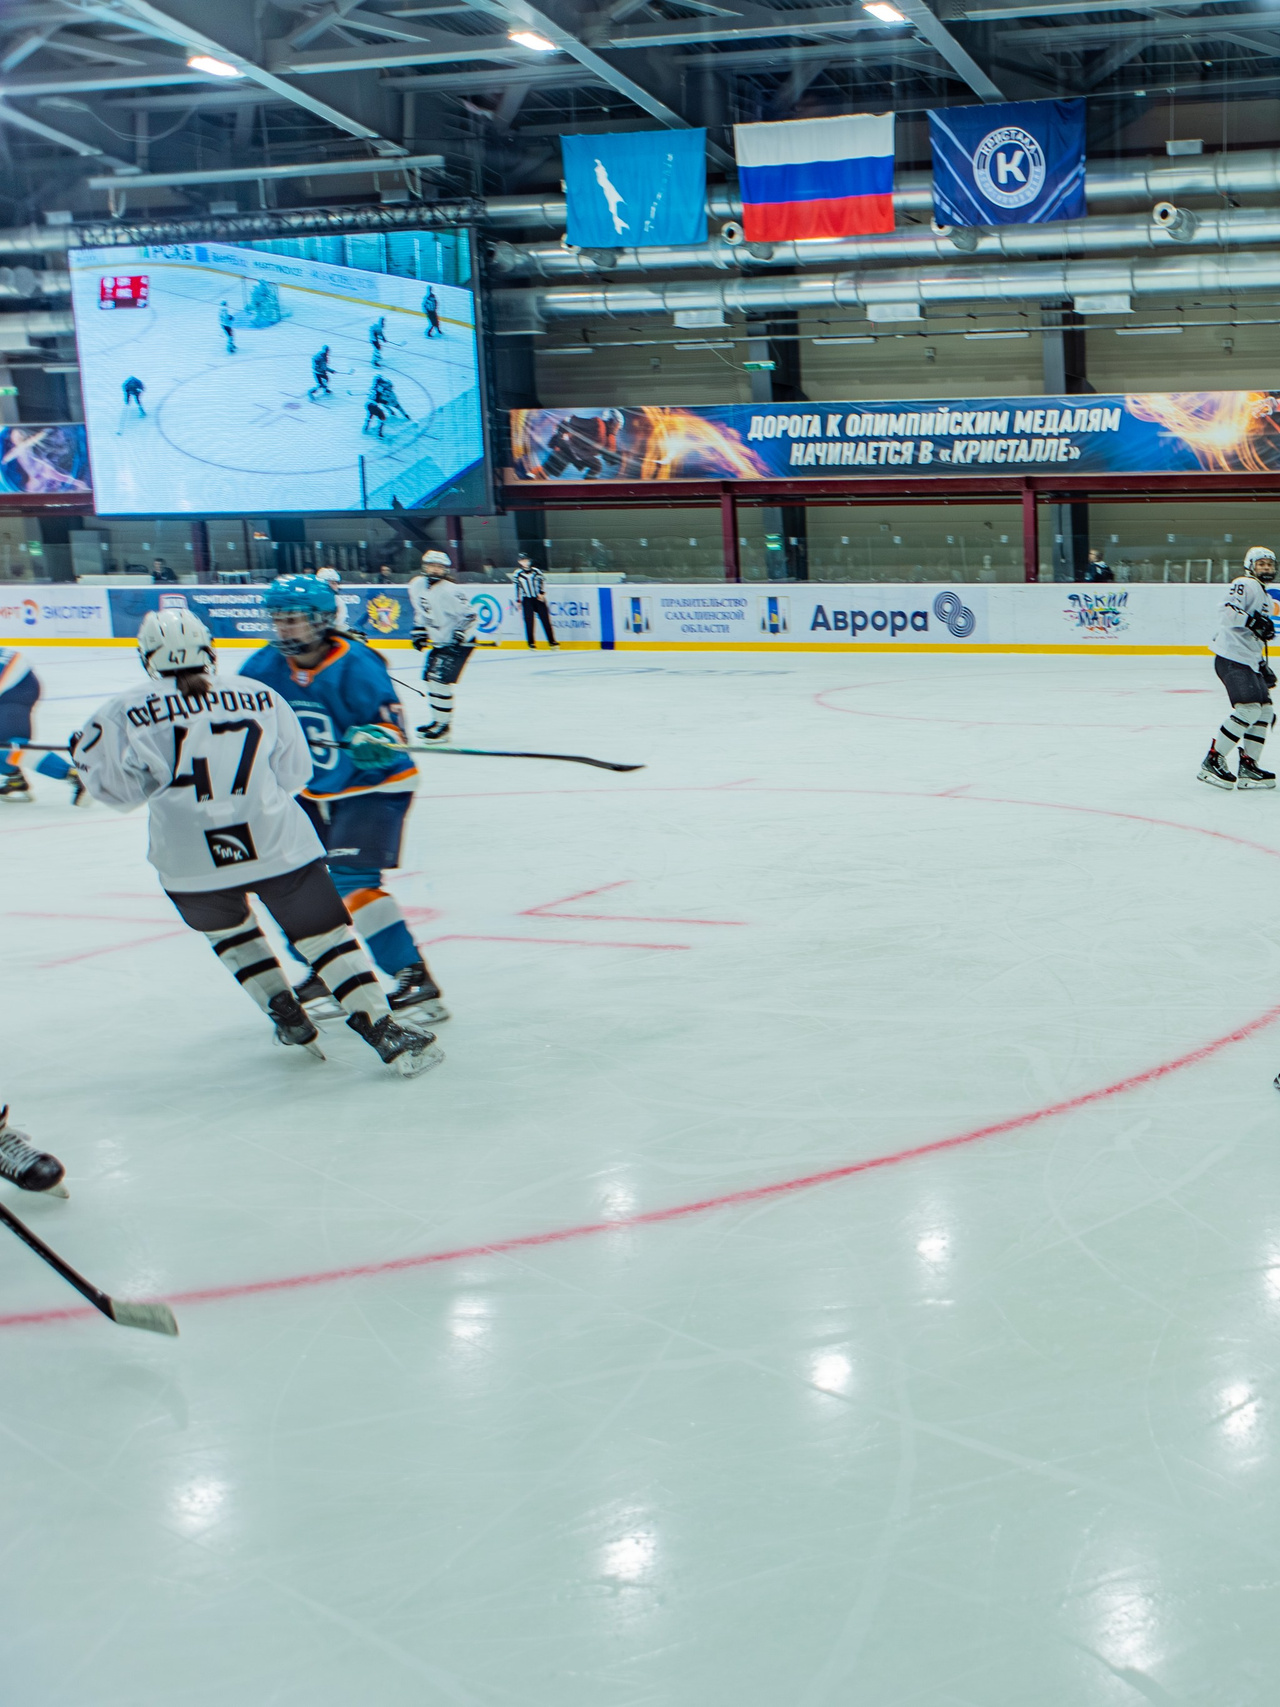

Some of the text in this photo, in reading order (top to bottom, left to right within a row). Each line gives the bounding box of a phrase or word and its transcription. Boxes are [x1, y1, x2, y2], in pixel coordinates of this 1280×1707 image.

[748, 407, 1122, 440] ДОРОГА К ОЛИМПИЙСКИМ МЕДАЛЯМ
[790, 438, 1082, 466] НАЧИНАЕТСЯ В «КРИСТАЛЛЕ»
[660, 598, 748, 608] ПРАВИТЕЛЬСТВО
[664, 610, 746, 621] САХАЛИНСКОЙ
[681, 624, 730, 634] ОБЛАСТИ
[810, 604, 929, 636] Аврора
[169, 649, 187, 665] 47
[127, 690, 274, 728] ФЁДОРОВА
[169, 718, 263, 803] 47
